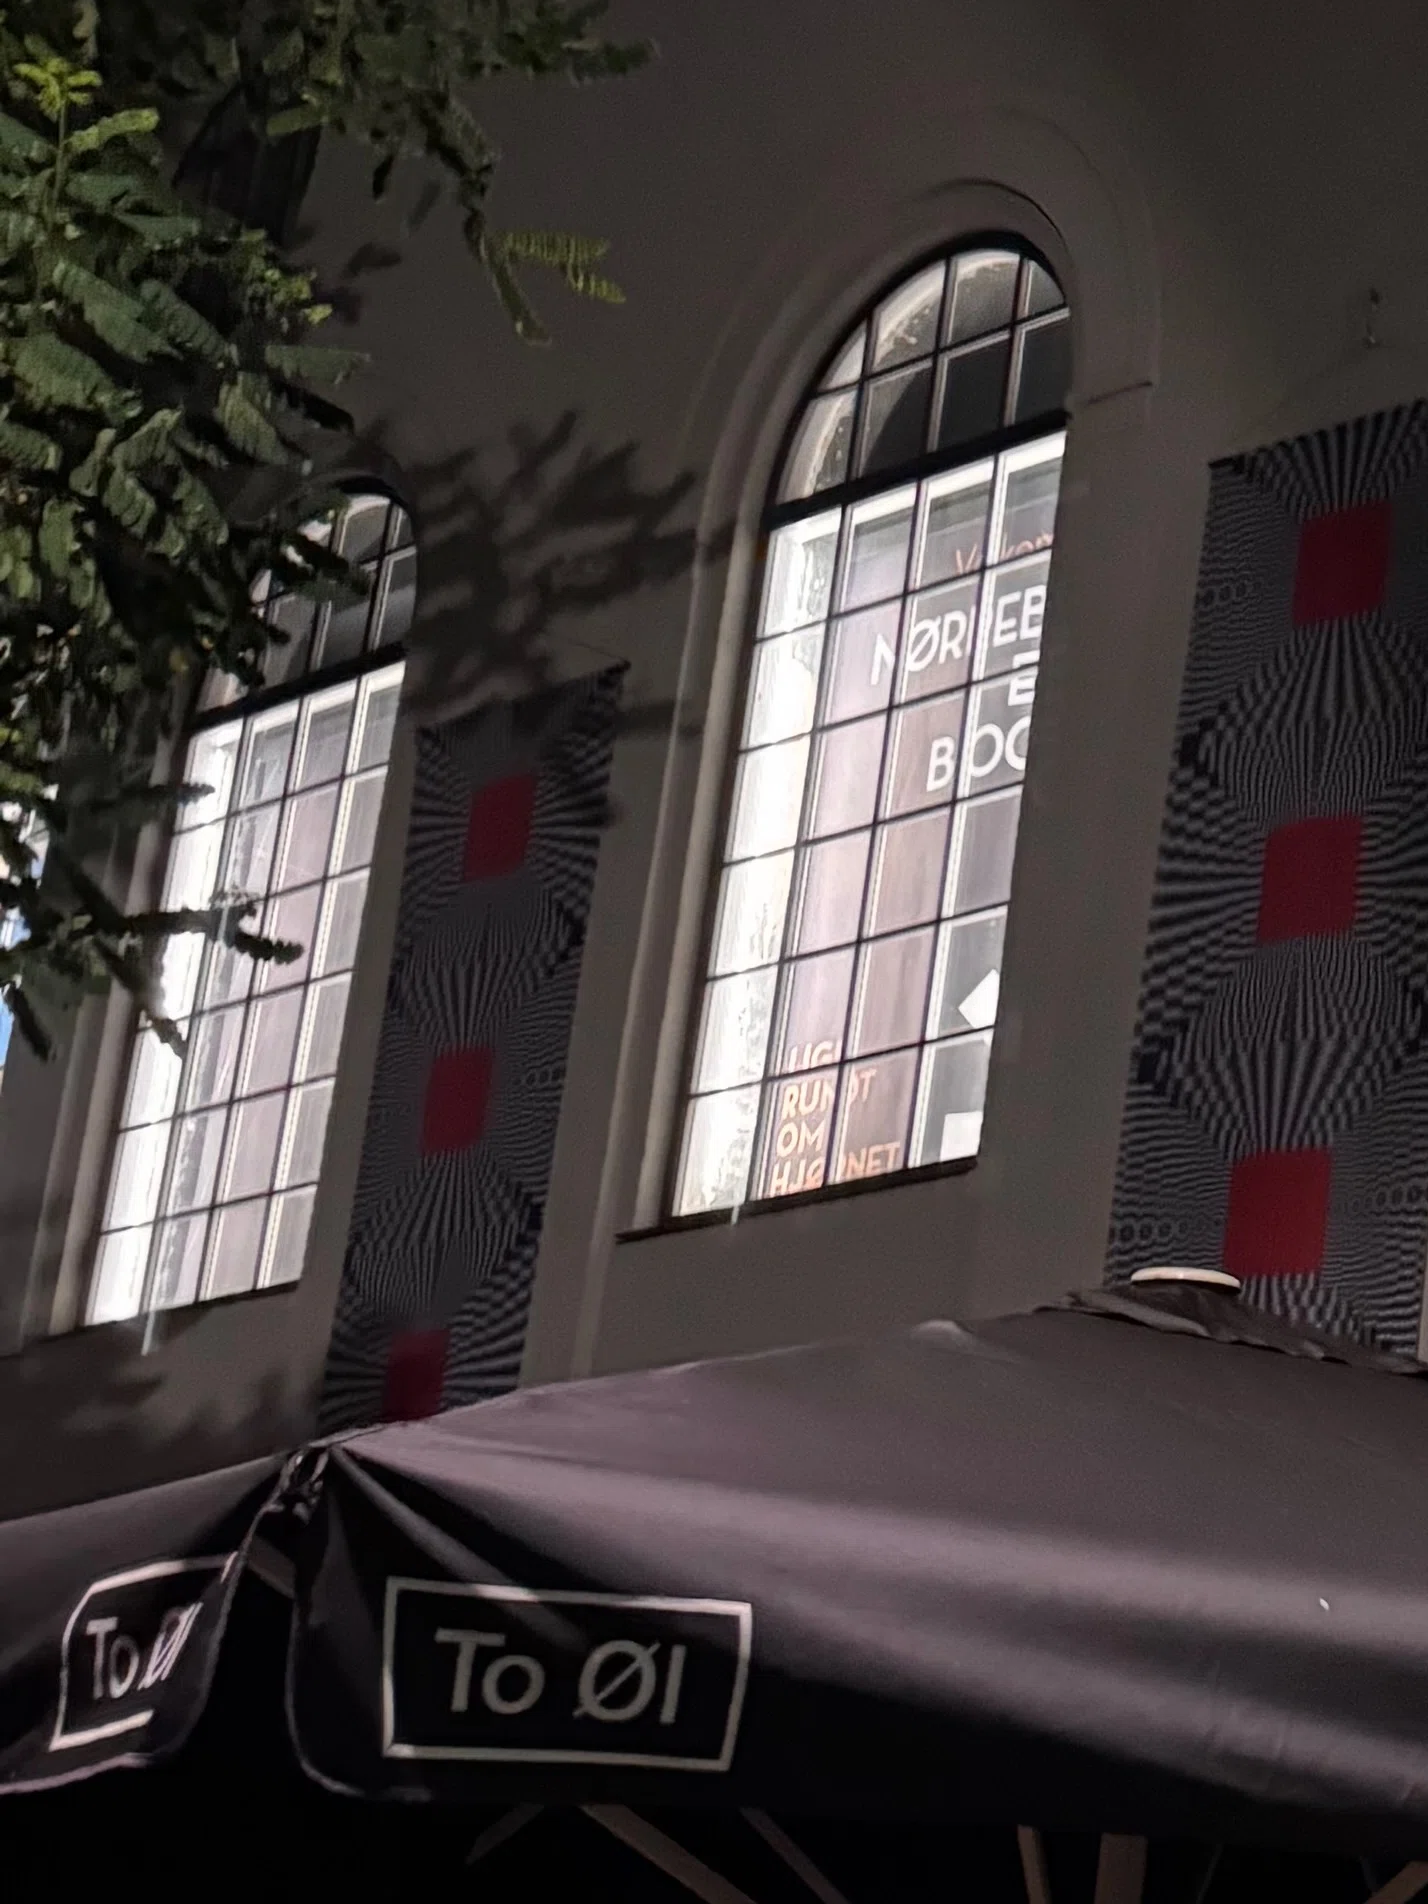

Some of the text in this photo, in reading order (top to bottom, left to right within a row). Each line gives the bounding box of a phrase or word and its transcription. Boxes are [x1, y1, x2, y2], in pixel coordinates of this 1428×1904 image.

[870, 584, 1047, 686] NØREB
[770, 1141, 901, 1198] HJØNET
[776, 1120, 825, 1159] OM
[86, 1615, 140, 1700] To
[433, 1626, 547, 1715] To
